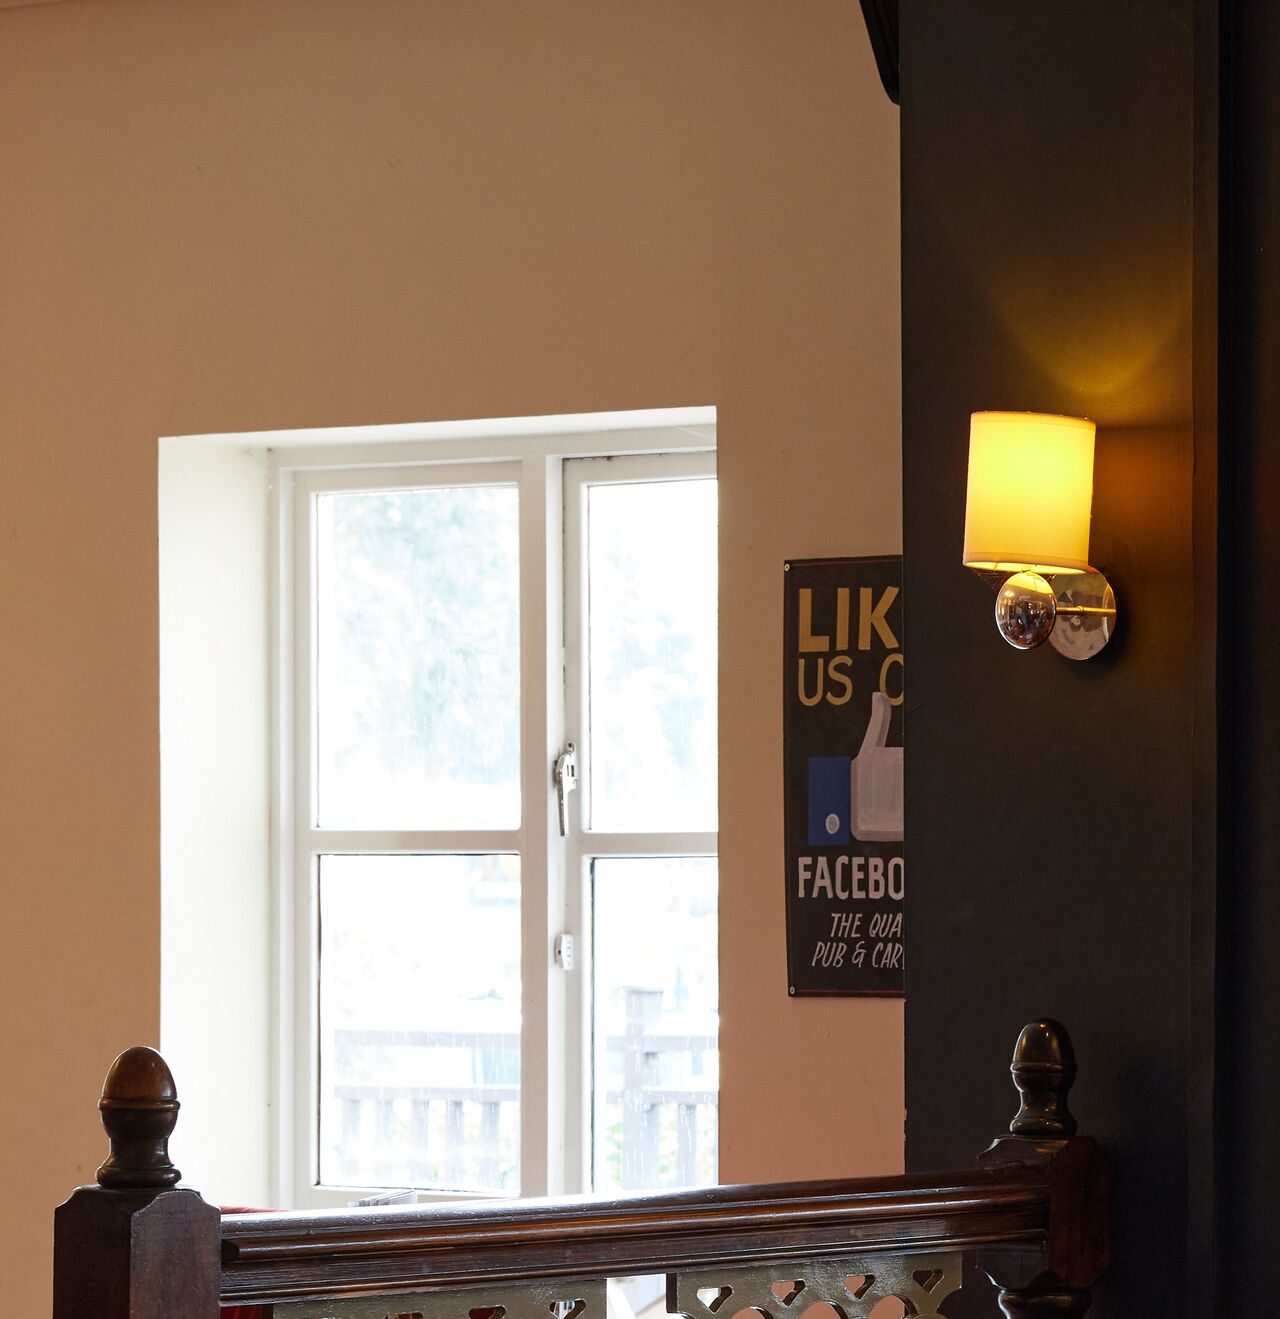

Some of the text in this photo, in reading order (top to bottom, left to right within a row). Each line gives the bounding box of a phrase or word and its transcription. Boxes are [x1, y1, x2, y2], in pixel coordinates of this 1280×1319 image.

[798, 586, 900, 652] LIK
[798, 655, 853, 707] US
[798, 855, 905, 900] FACEBO
[830, 912, 903, 938] THE QUA
[811, 941, 905, 970] PUB & CAR
